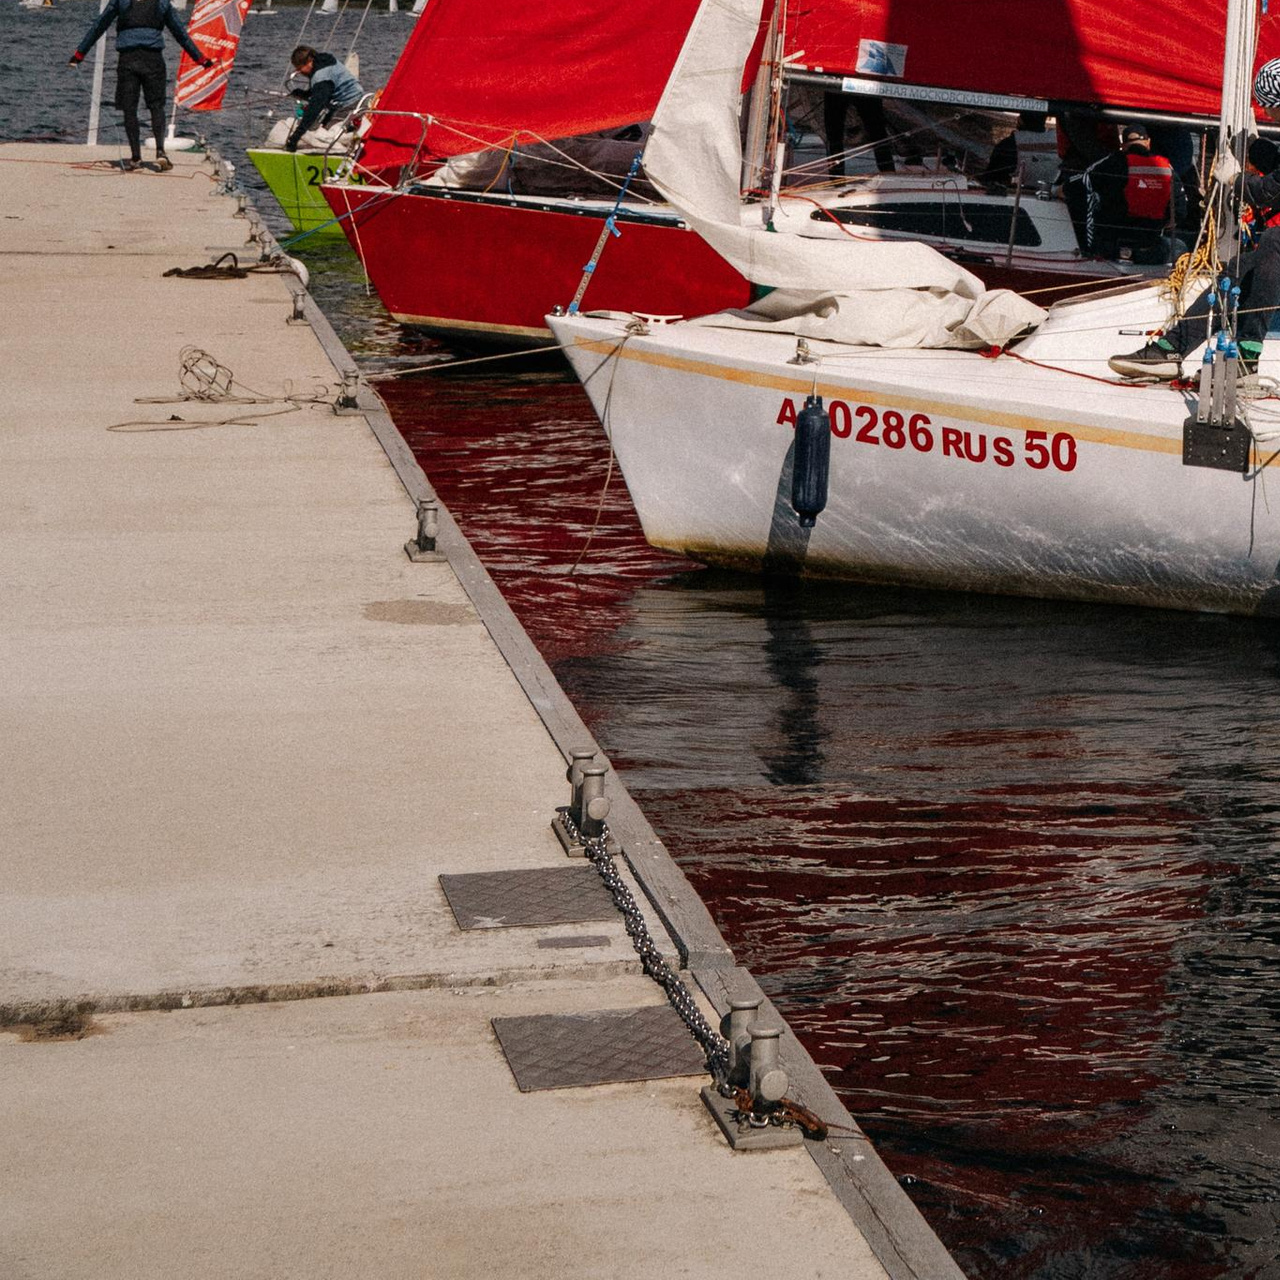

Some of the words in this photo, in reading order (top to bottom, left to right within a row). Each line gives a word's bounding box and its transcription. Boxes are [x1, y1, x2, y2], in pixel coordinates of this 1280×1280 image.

[776, 397, 934, 453] A0286
[942, 426, 1015, 468] RUS
[1024, 430, 1078, 473] 50
